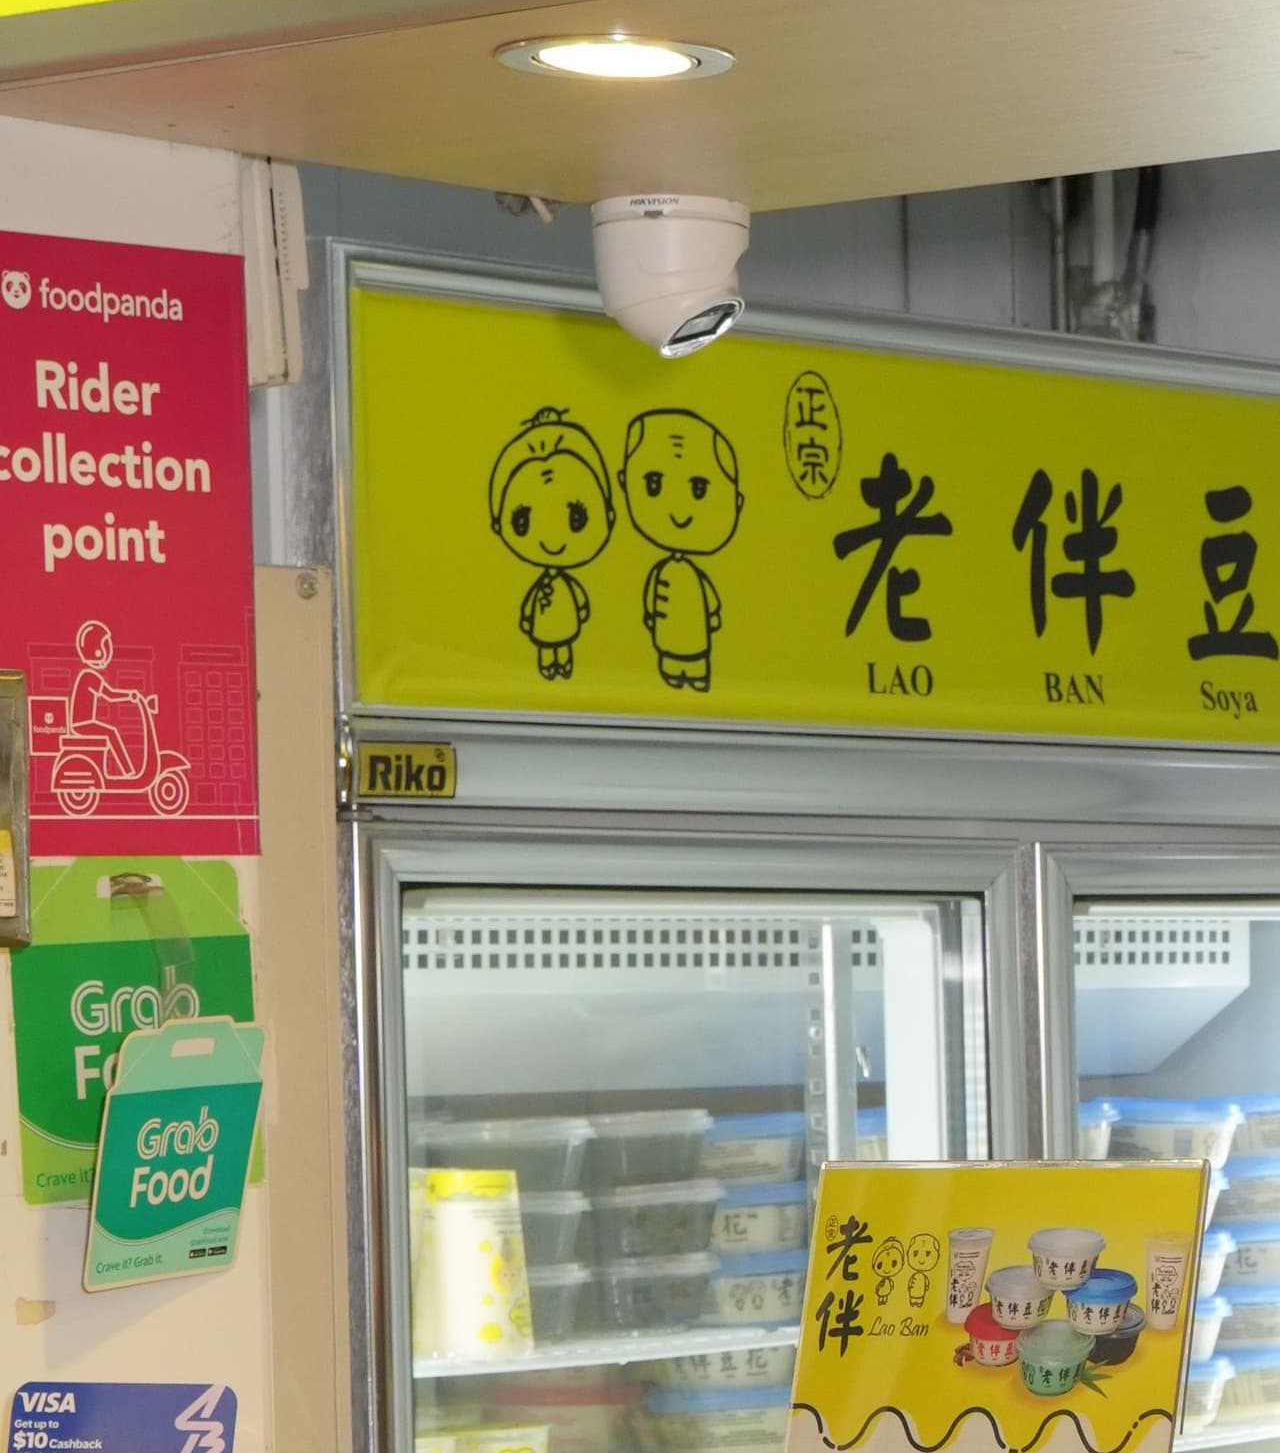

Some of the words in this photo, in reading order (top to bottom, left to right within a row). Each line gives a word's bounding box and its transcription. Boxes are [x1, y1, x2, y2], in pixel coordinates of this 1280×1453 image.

[39, 277, 184, 322] foodpanda
[35, 359, 160, 417] Rider
[795, 387, 829, 485] 正宗
[44, 513, 166, 572] point
[866, 662, 933, 697] LAO
[1043, 671, 1105, 705] BAN
[1200, 679, 1258, 719] Soya
[368, 755, 448, 794] Riko
[70, 965, 200, 1037] Grab
[137, 1106, 220, 1160] Grab
[36, 1169, 76, 1189] Crave
[129, 1154, 214, 1208] Food
[816, 1215, 873, 1358] 老伴
[868, 1316, 895, 1337] Lao
[900, 1316, 929, 1337] Ban
[14, 1419, 33, 1429] Get
[34, 1421, 47, 1430] up
[48, 1420, 59, 1429] to
[18, 1392, 76, 1413] VISA
[13, 1431, 48, 1451] $10
[49, 1438, 102, 1449] Cashback
